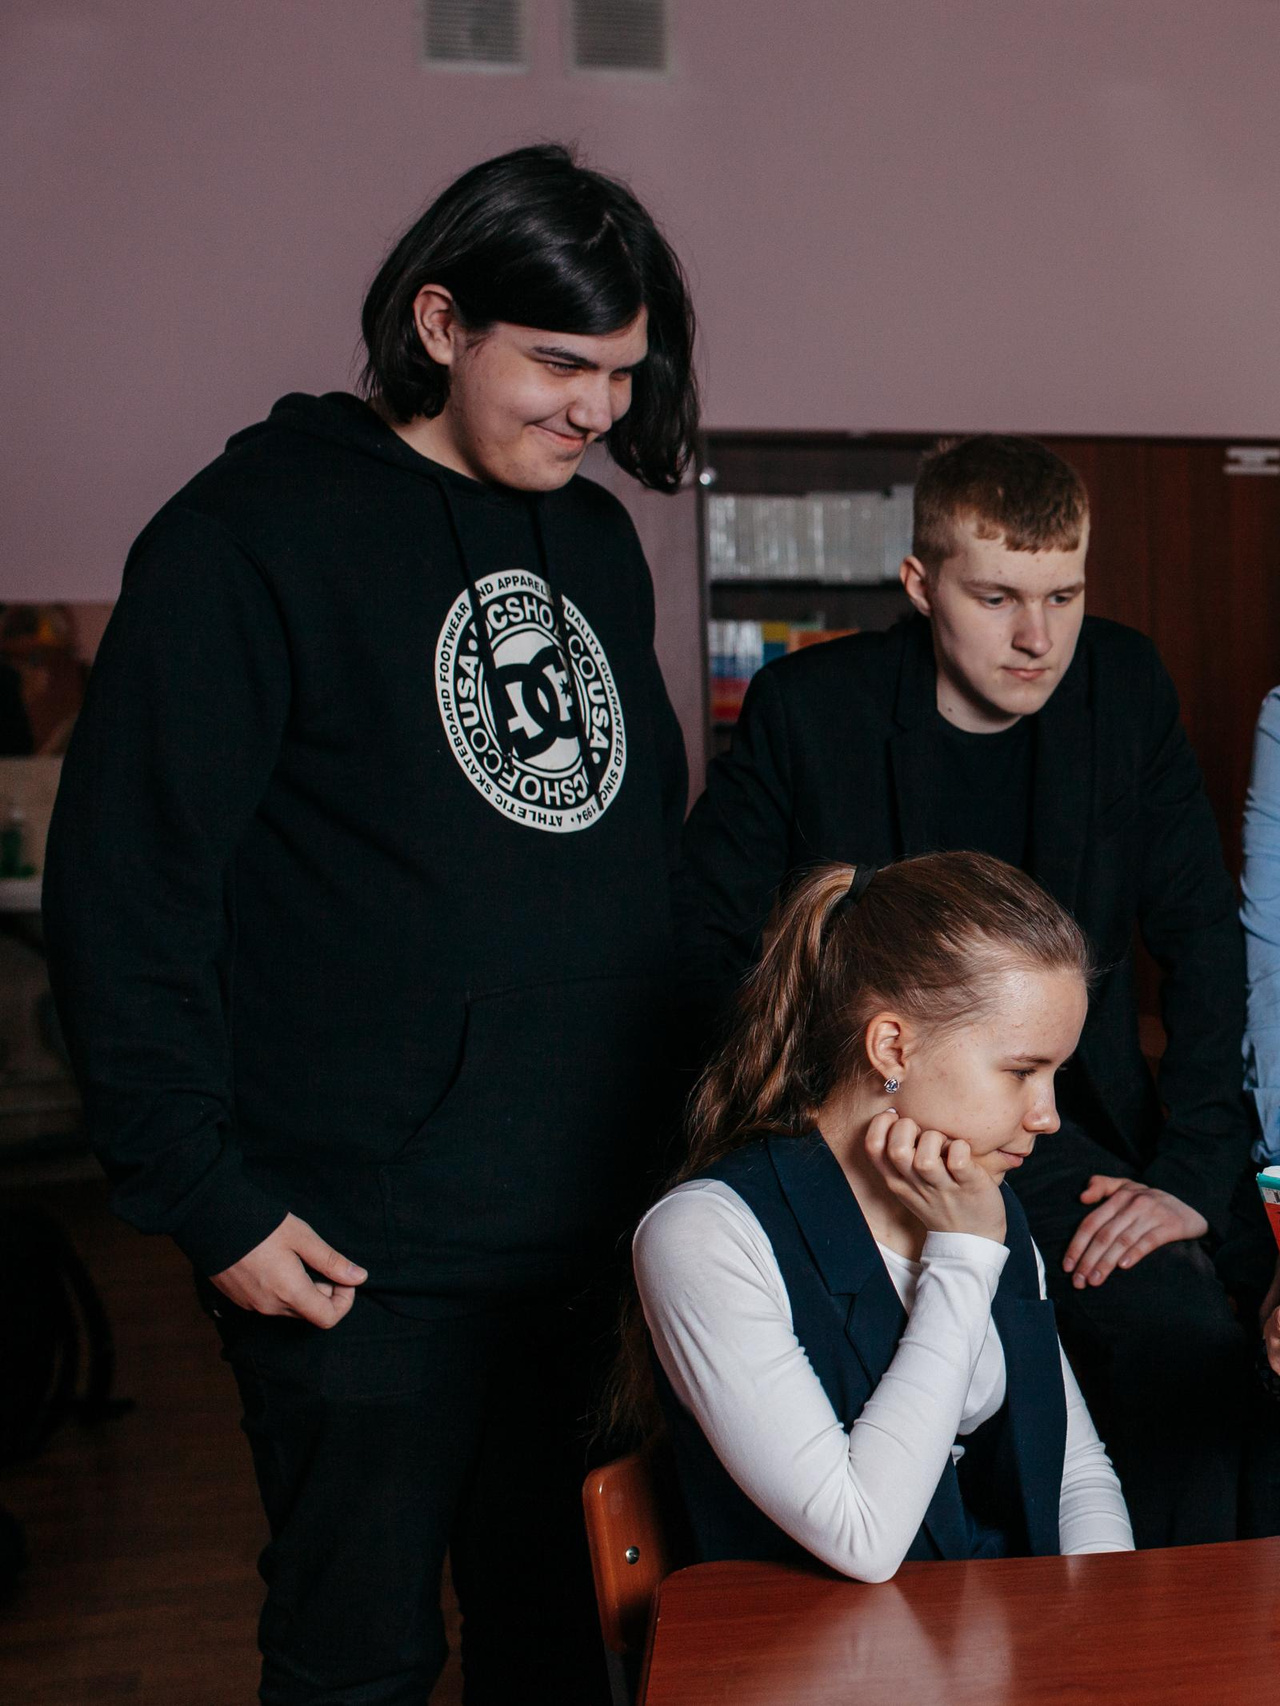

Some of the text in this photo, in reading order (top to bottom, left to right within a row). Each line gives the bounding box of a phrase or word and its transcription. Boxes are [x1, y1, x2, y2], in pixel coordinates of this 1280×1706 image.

[440, 575, 624, 827] ATHLETIC SKATEBOARD FOOTWEAR ND APPAREL UALITY GUARANTEED SINC 1994
